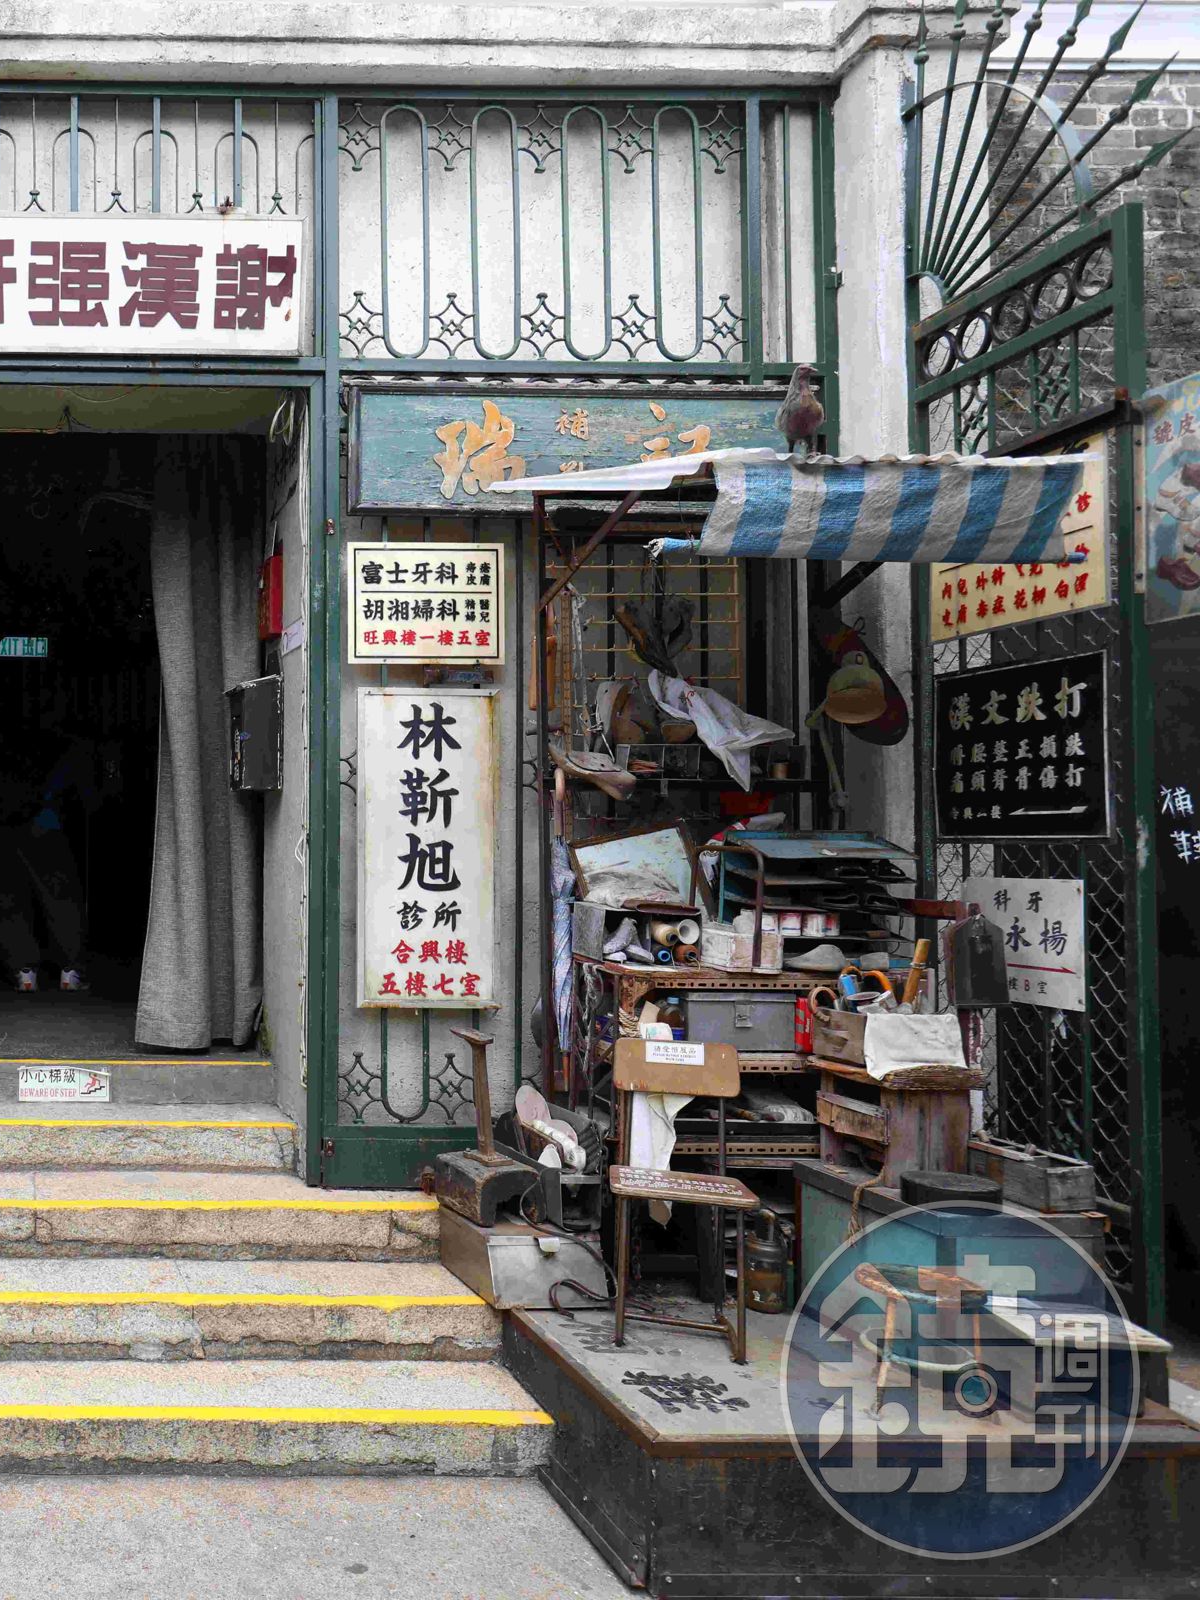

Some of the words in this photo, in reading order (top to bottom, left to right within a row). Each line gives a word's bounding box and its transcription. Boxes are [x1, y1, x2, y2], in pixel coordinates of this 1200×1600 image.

[361, 561, 458, 585] 富士牙科
[362, 598, 459, 622] 胡湘婦科
[363, 629, 491, 647] 旺興樓一樓五室
[397, 703, 462, 892] 林靳旭
[993, 889, 1043, 913] 牙科
[397, 900, 462, 932] 診所
[391, 939, 469, 965] 合興樓
[378, 971, 481, 997] 五樓七室
[20, 1068, 76, 1083] 小心梯級
